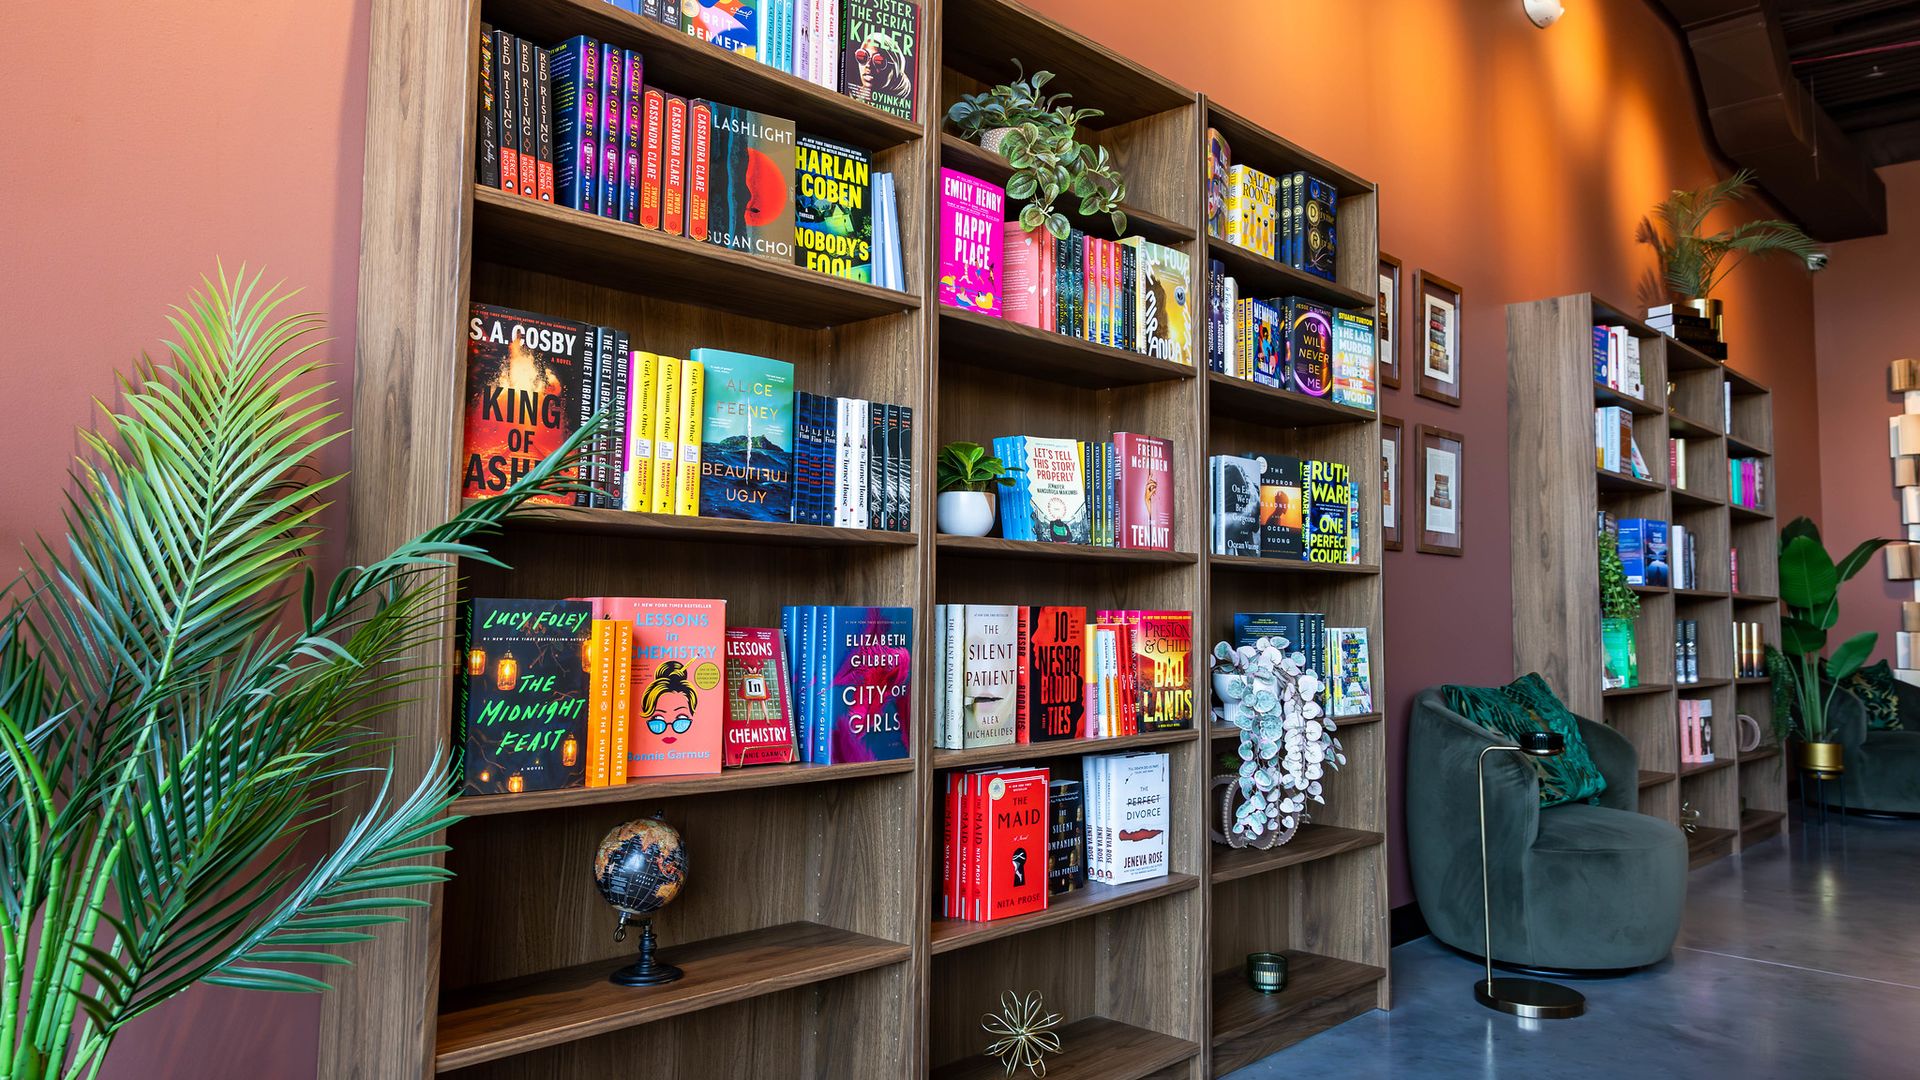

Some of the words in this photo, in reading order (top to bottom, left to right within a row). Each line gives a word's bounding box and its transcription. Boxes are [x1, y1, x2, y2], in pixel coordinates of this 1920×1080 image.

[703, 12, 732, 31] BRIT
[852, 4, 872, 22] THE
[876, 12, 914, 34] SERIAL
[688, 24, 748, 54] BENNETT
[850, 19, 913, 56] KILLER
[503, 36, 511, 65] RED
[586, 42, 595, 88] SOCIETY
[503, 71, 512, 129] RISING
[522, 78, 530, 136] RISING
[586, 93, 594, 108] OF
[872, 91, 911, 109] OYINKAN
[648, 99, 658, 150] CASSANDRA
[670, 106, 681, 156] CASSANDRA
[647, 152, 657, 180] CLARE
[670, 158, 680, 186] CLARE
[796, 146, 868, 186] HARLAN
[802, 174, 862, 209] COBEN
[945, 178, 972, 206] EMILY
[976, 186, 1001, 213] HENRY
[1243, 182, 1275, 207] ROONEY
[1282, 178, 1291, 208] Divine
[956, 211, 992, 245] HAPPY
[1282, 208, 1291, 236] Rivals
[707, 230, 750, 250] SUSAN
[756, 239, 792, 256] CHOI
[796, 226, 869, 261] NOBODY'S
[955, 238, 990, 270] PLACE
[1338, 312, 1357, 322] STUART
[1357, 316, 1372, 326] TURTON
[1304, 322, 1324, 335] YOU
[1340, 326, 1353, 338] THE
[1354, 330, 1372, 343] LAST
[512, 324, 576, 356] COSBY
[584, 331, 594, 348] THE
[1304, 335, 1325, 349] WILL
[1340, 340, 1372, 356] MURDER
[1299, 348, 1329, 361] NEVER
[583, 350, 593, 381] QUIET
[1308, 364, 1320, 375] BE
[726, 378, 773, 397] ALICE
[1308, 377, 1320, 388] ME
[1349, 379, 1363, 390] THE
[581, 382, 592, 428] LIBRARIAN
[1343, 390, 1372, 404] WORLD
[482, 386, 561, 430] KING
[717, 400, 778, 420] FEENEY
[508, 429, 535, 454] OF
[1138, 443, 1162, 458] FREIDA
[1034, 447, 1053, 460] LET'S
[1054, 450, 1072, 461] TELL
[702, 462, 788, 483] BEAUTIFUL
[1033, 458, 1049, 469] THIS
[1051, 460, 1075, 472] STORY
[1132, 456, 1168, 472] McFADDEN
[1312, 460, 1350, 484] RUTH
[1037, 470, 1074, 482] PROPERLY
[726, 488, 767, 504] UGLY
[1312, 482, 1349, 504] WARE
[1232, 513, 1255, 525] Gorgeous
[1319, 515, 1343, 535] ONE
[1131, 525, 1169, 548] TENANT
[1228, 540, 1244, 550] Ocean
[1310, 534, 1347, 549] PERFECT
[1310, 550, 1347, 564] COUPLE
[483, 610, 532, 630] LUCY
[533, 612, 588, 632] FOLEY
[636, 613, 709, 627] LESSONS
[1054, 611, 1068, 642] JO
[666, 631, 678, 642] in
[984, 624, 999, 635] THE
[1145, 622, 1191, 638] PRESTON
[727, 641, 772, 656] LESSONS
[846, 634, 906, 646] ELIZABETH
[1144, 640, 1155, 654] &
[1157, 638, 1192, 654] CHILD
[632, 646, 716, 660] CHEMISTRY
[851, 654, 900, 667] GILBERT
[969, 644, 1013, 660] SILENT
[966, 670, 1015, 687] PATIENT
[1154, 658, 1184, 688] BAD
[519, 675, 557, 693] THE
[748, 678, 762, 693] In
[1040, 676, 1077, 704] BLOOD
[842, 685, 889, 705] CITY
[892, 686, 906, 696] OF
[477, 698, 586, 726] MIDNIGHT
[1144, 690, 1192, 722] LANDS
[849, 712, 900, 734] GIRLS
[982, 715, 999, 725] ALEX
[1047, 706, 1071, 736] TIES
[496, 729, 566, 755] FEAST
[729, 727, 787, 743] CHEMISTRY
[967, 728, 1013, 739] MICHAELIDES
[628, 752, 664, 762] Bonnie
[668, 749, 710, 760] Garmus
[735, 751, 759, 760] BONNIE
[761, 750, 788, 760] GARMUS
[1012, 796, 1028, 806] THE
[1126, 794, 1160, 807] PERFECT
[998, 808, 1040, 829] MAID
[1126, 808, 1161, 820] DIVORCE
[1052, 822, 1073, 833] SILENT
[1124, 854, 1147, 869] JENEVA
[1148, 851, 1162, 865] ROSE
[997, 899, 1015, 909] NITA
[1017, 893, 1040, 905] PROSE
